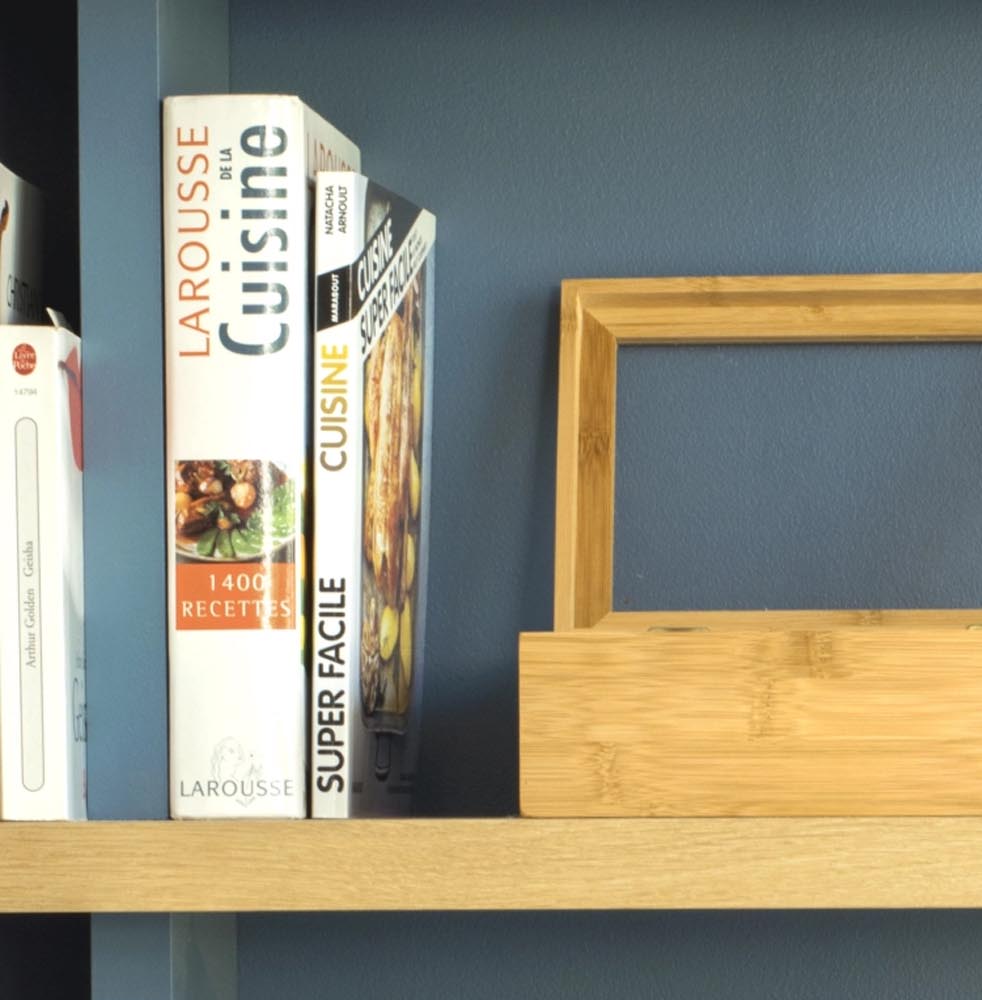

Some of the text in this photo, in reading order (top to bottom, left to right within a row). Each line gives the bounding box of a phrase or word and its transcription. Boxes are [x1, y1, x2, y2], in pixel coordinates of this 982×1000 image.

[219, 148, 232, 181] DE LA
[218, 124, 290, 356] Cuisine
[325, 184, 334, 236] NATACHA
[338, 185, 348, 235] ARNOULT
[177, 126, 210, 357] LAROUSSE
[357, 217, 394, 302] CUISINE
[330, 274, 340, 323] MARABOUT
[360, 282, 389, 355] SUPER
[320, 344, 349, 473] CUISINE
[22, 540, 36, 669] Arthur Golden Geisha
[182, 600, 292, 618] RECETTES
[208, 573, 270, 592] 1400
[316, 577, 346, 793] SUPER FACILE
[180, 779, 295, 797] LAROUSSE
